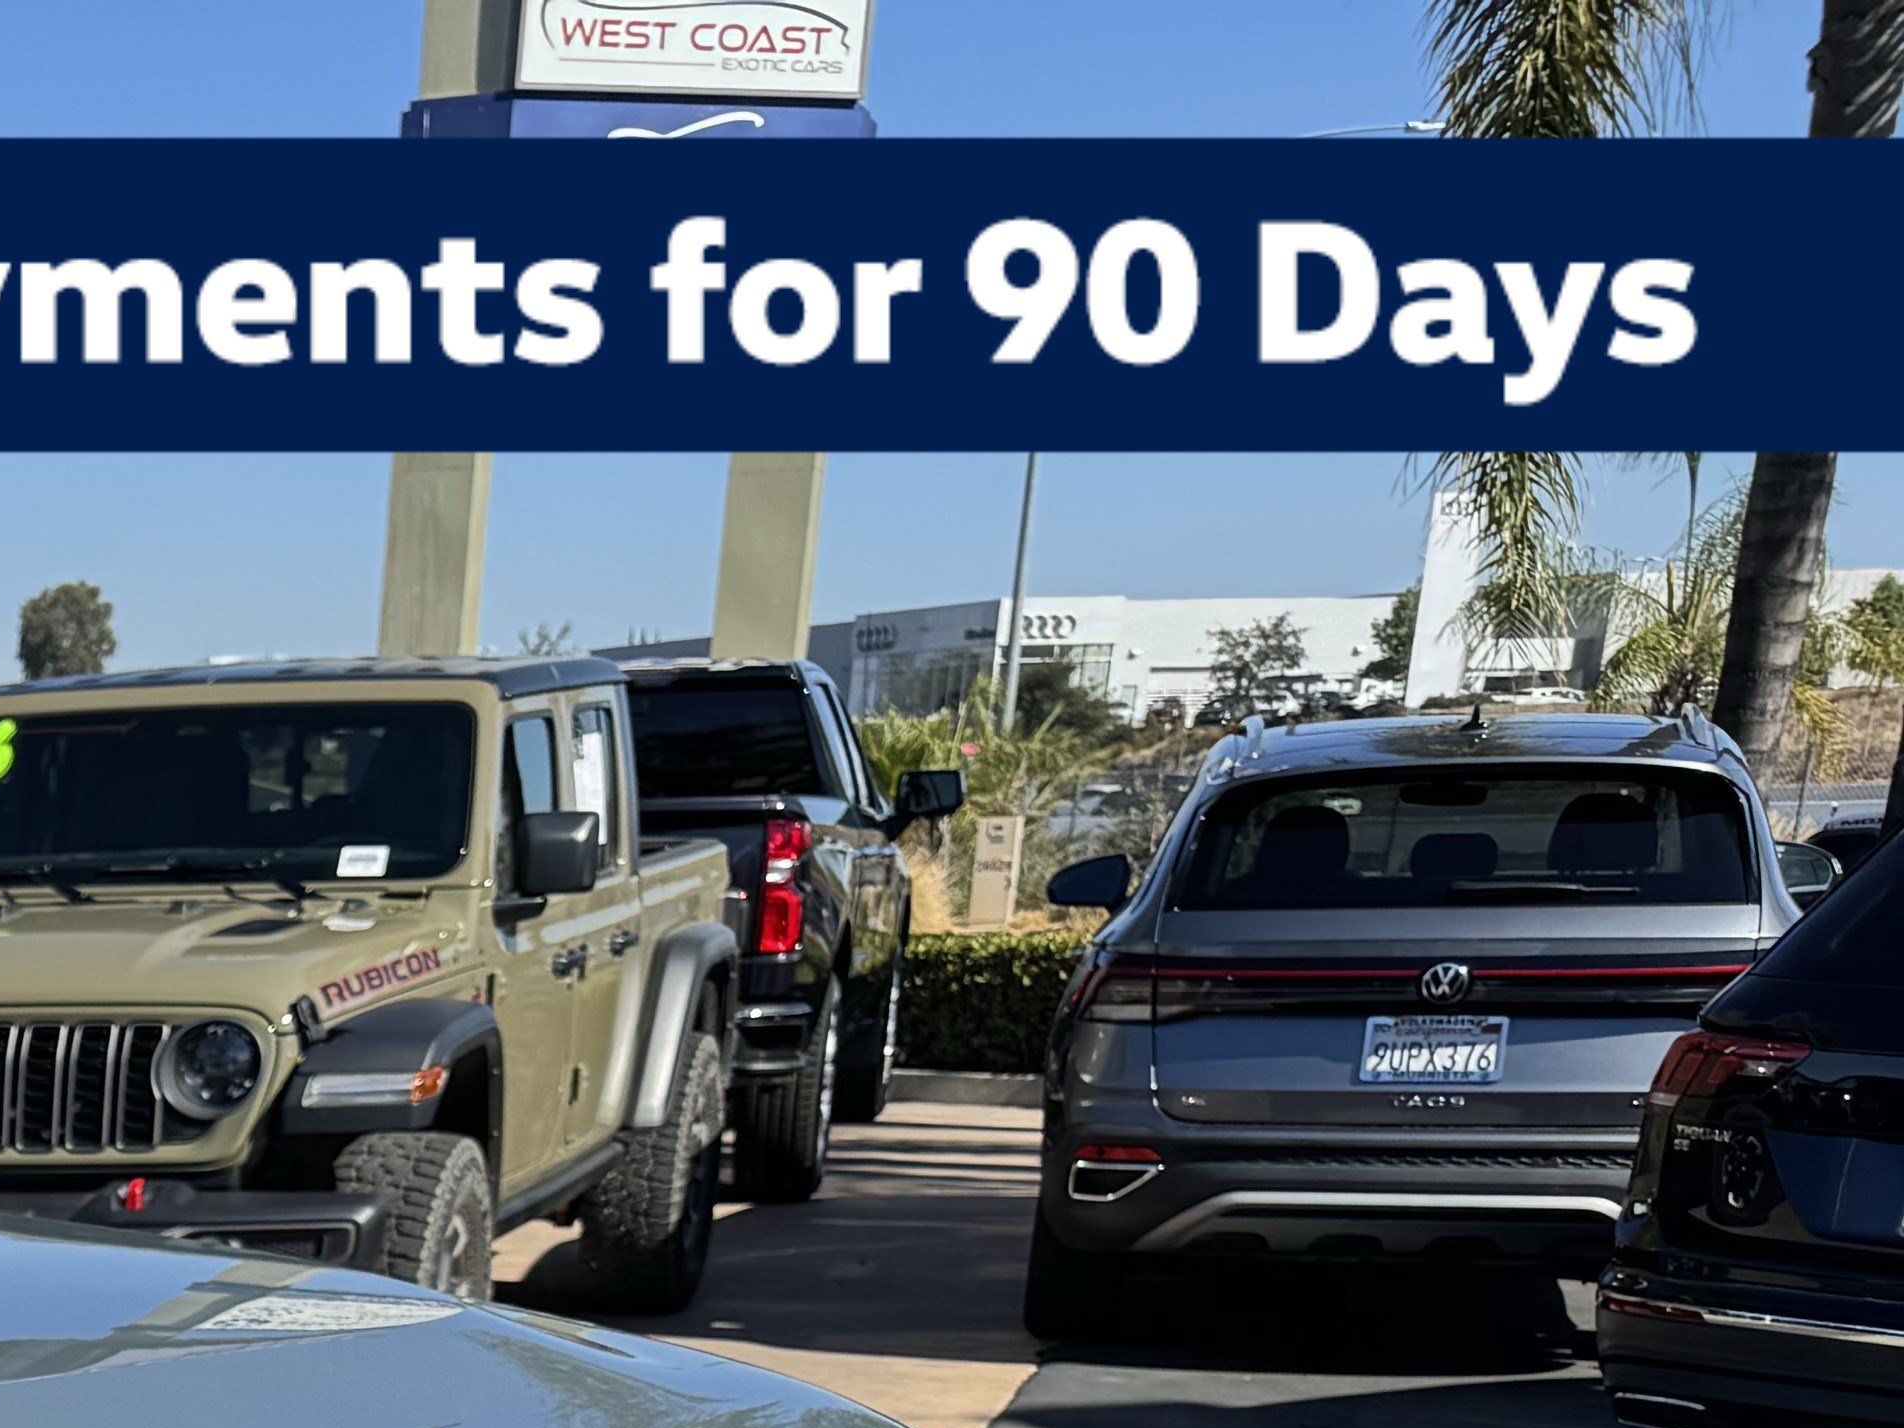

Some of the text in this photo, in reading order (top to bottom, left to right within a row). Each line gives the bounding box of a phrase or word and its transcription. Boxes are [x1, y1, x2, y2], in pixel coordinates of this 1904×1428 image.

[560, 17, 833, 55] WEST COAST
[720, 57, 845, 75] EXOTIC CARS
[320, 947, 441, 1008] RUBICON
[1373, 1041, 1495, 1073] 9UPX376
